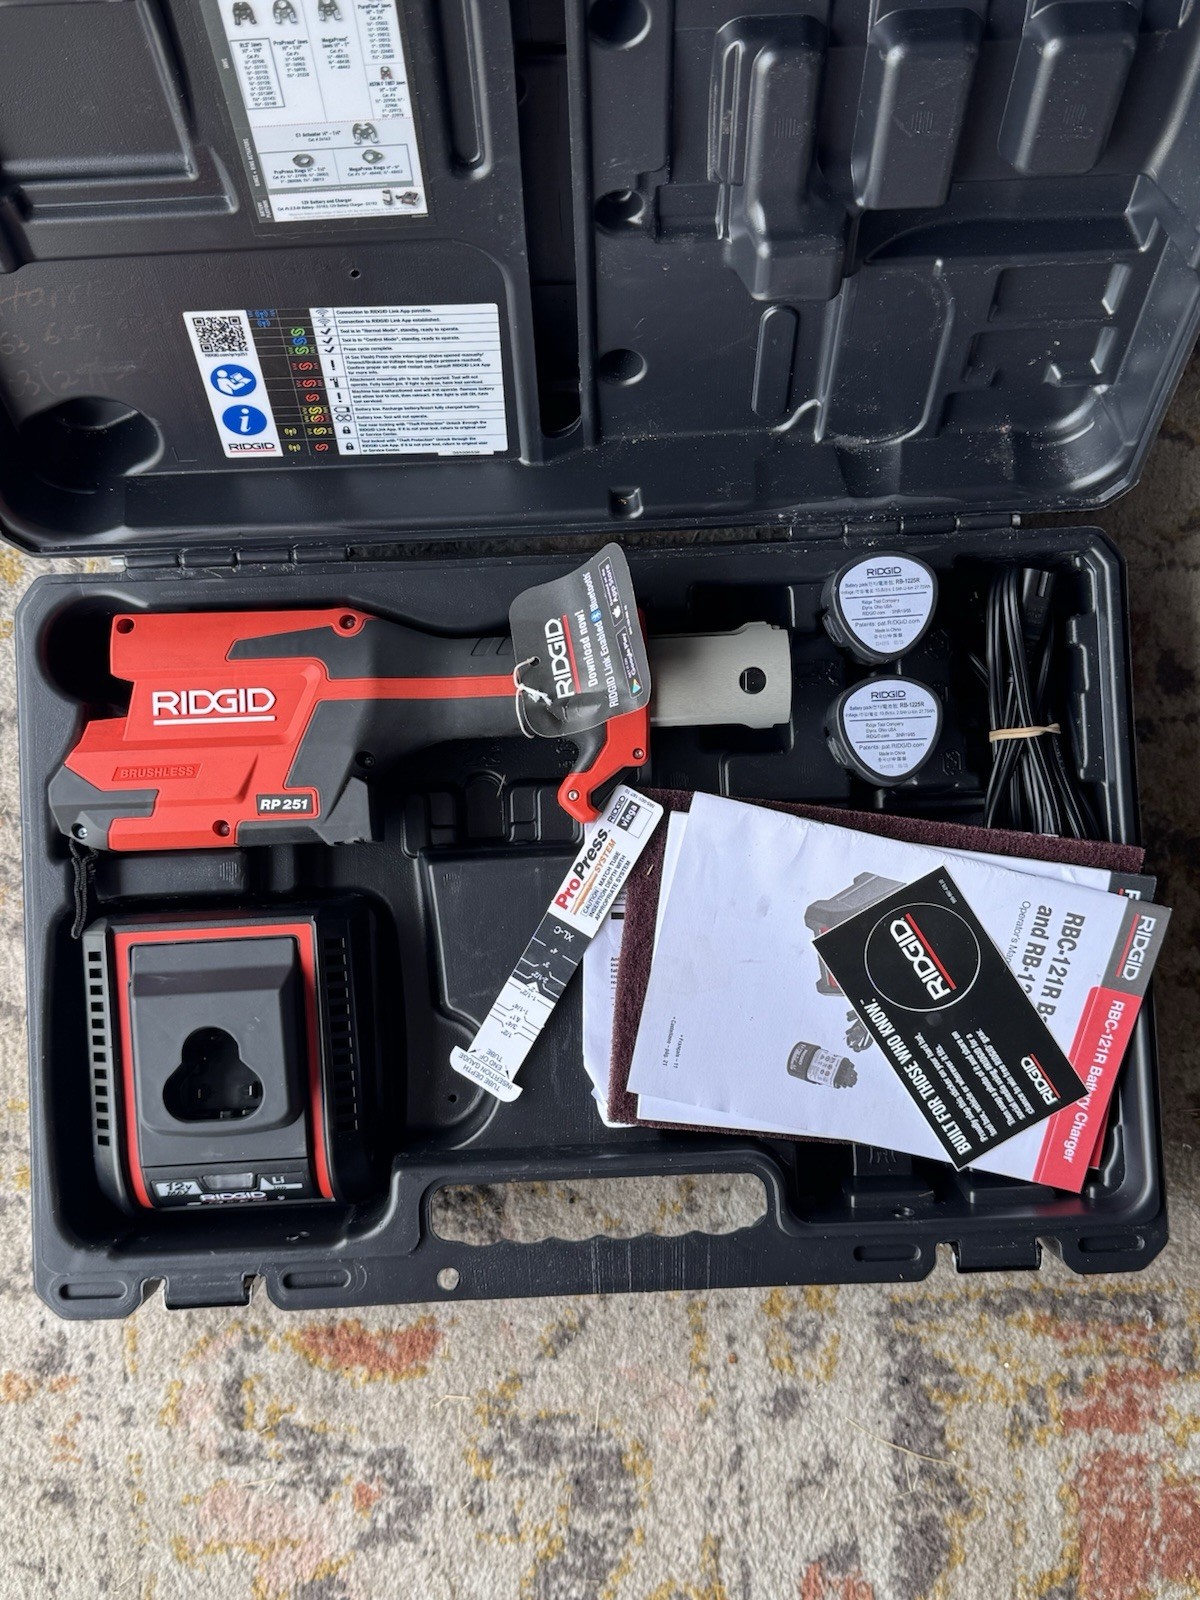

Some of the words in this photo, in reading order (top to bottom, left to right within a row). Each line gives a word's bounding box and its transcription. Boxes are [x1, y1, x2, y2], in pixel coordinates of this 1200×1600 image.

[229, 442, 275, 450] RIDGID
[605, 563, 615, 586] Store
[867, 567, 901, 576] RIDGID
[574, 609, 587, 635] now!
[594, 620, 609, 655] Enabled
[544, 617, 575, 699] RIDGID
[580, 635, 598, 687] Download
[601, 655, 613, 676] Link
[152, 687, 276, 716] RIDGID
[606, 676, 619, 708] RIDGID
[871, 691, 906, 699] RIDGID
[120, 766, 194, 779] BRUSHLESS
[260, 800, 282, 810] RP
[282, 799, 308, 810] 251
[606, 794, 626, 823] RIDGID
[619, 802, 639, 828] viega
[593, 838, 617, 873] SYSTEM
[582, 888, 599, 914] CAUTION
[598, 866, 612, 886] MATCH
[609, 850, 620, 867] TUBE
[588, 887, 607, 917] INSERTION
[604, 868, 618, 888] DEPTH
[615, 854, 626, 869] WITH
[593, 882, 618, 921] APPROPRIATE
[615, 859, 631, 883] SYSTEM
[1009, 899, 1031, 944] Operator's
[1031, 905, 1053, 941] and
[552, 924, 575, 942] XL-C
[1040, 911, 1085, 1001] RBC-121R
[1121, 913, 1156, 982] RIDGID
[889, 917, 951, 1001] RIDGID
[862, 997, 895, 1038] KNOW.
[913, 1031, 926, 1045] hat,
[950, 1030, 960, 1040] on
[1092, 999, 1124, 1065] RBC-121R
[485, 1048, 504, 1062] TUBE
[885, 1033, 913, 1065] WHO
[920, 1042, 934, 1058] hard
[933, 1043, 945, 1057] fits.
[955, 1037, 971, 1056] share
[456, 1051, 481, 1069] GAUGE
[478, 1053, 489, 1062] OF
[487, 1059, 502, 1070] END
[929, 1055, 943, 1071] your
[940, 1054, 949, 1062] it
[965, 1053, 978, 1067] and
[461, 1063, 485, 1081] DEPTH
[479, 1066, 514, 1089] INSERTION
[938, 1068, 947, 1078] on
[943, 1059, 965, 1087] wherever
[972, 1064, 981, 1072] it
[975, 1068, 985, 1078] of
[482, 1076, 501, 1091] TUBE
[902, 1059, 936, 1100] THOSE
[941, 1076, 960, 1098] sticker
[960, 1084, 970, 1093] or
[979, 1074, 996, 1094] photo
[1018, 1053, 1058, 1106] RIDGID
[925, 1095, 951, 1124] FOR
[954, 1095, 967, 1109] this
[964, 1091, 982, 1114] vehicle
[993, 1094, 1008, 1111] snap
[961, 1105, 975, 1121] slap
[977, 1110, 991, 1125] box,
[1001, 1109, 1016, 1126] Then
[940, 1117, 972, 1156] BUILT
[968, 1117, 989, 1143] Proudly
[984, 1122, 997, 1137] tool
[1063, 1110, 1089, 1163] Charger
[200, 1192, 266, 1200] RIDGID
